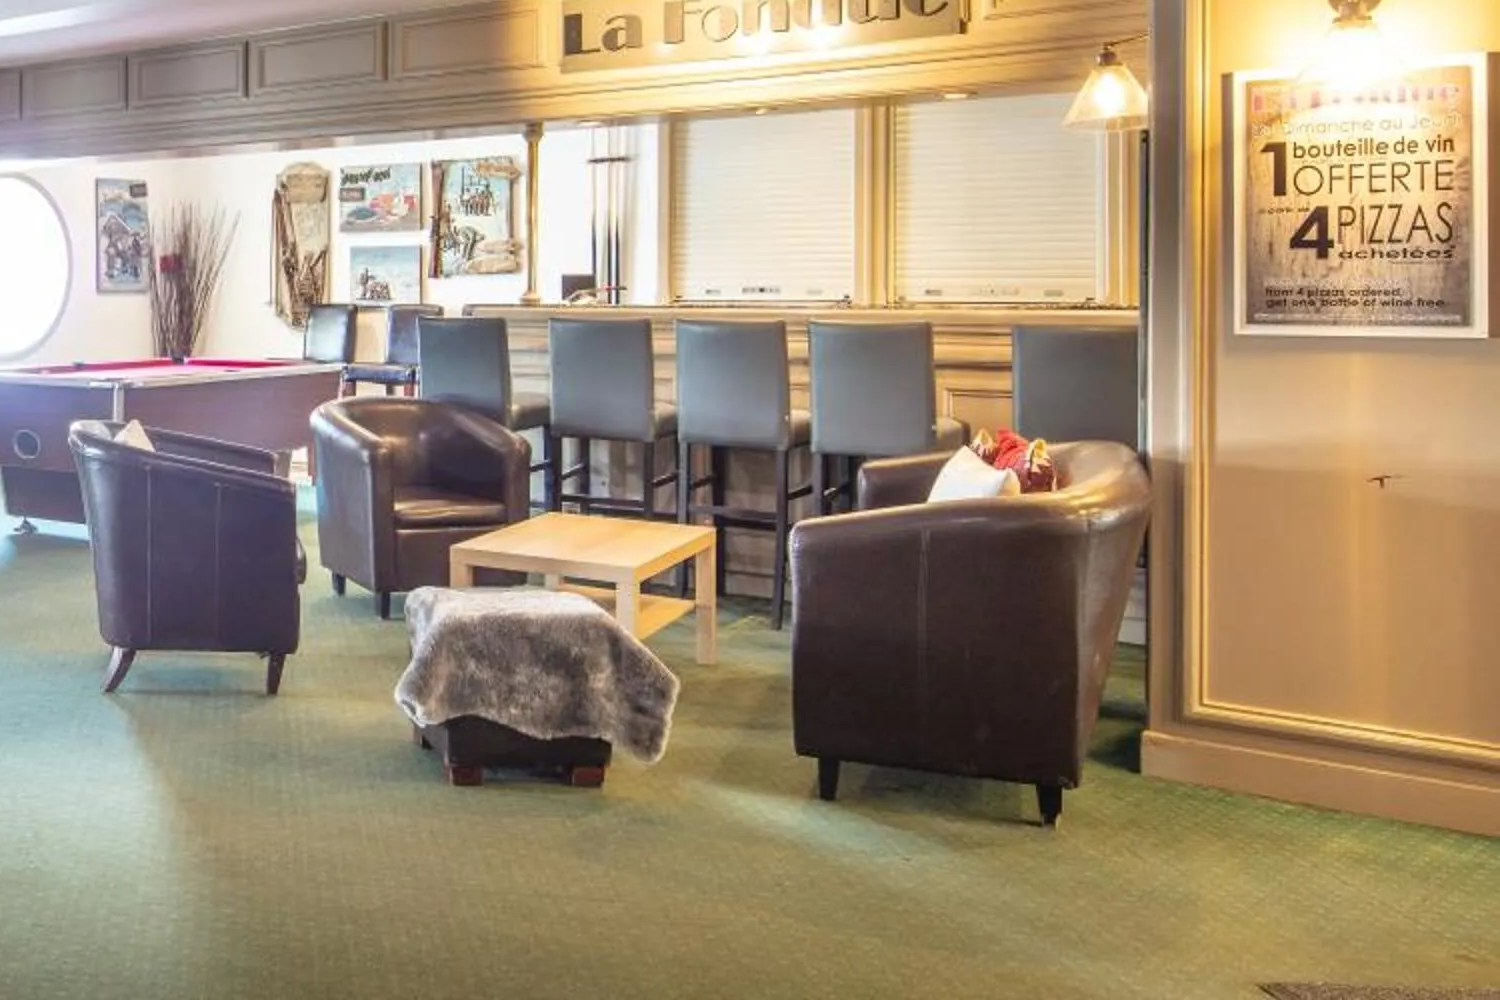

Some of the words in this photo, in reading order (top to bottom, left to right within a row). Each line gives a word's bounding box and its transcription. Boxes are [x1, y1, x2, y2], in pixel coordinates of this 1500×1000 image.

[563, 13, 643, 56] La
[1260, 141, 1287, 197] 1
[1293, 138, 1389, 158] bouteille
[1393, 136, 1419, 154] de
[1425, 134, 1455, 152] vin
[1293, 160, 1455, 196] OFFERTE
[1289, 205, 1335, 260] 4
[1337, 202, 1453, 245] PIZZAS
[1266, 298, 1287, 309] get
[1320, 297, 1356, 307] bottle
[1362, 297, 1376, 307] of
[1380, 297, 1413, 307] wine
[1296, 287, 1303, 297] 4
[1306, 287, 1345, 299] pizzas
